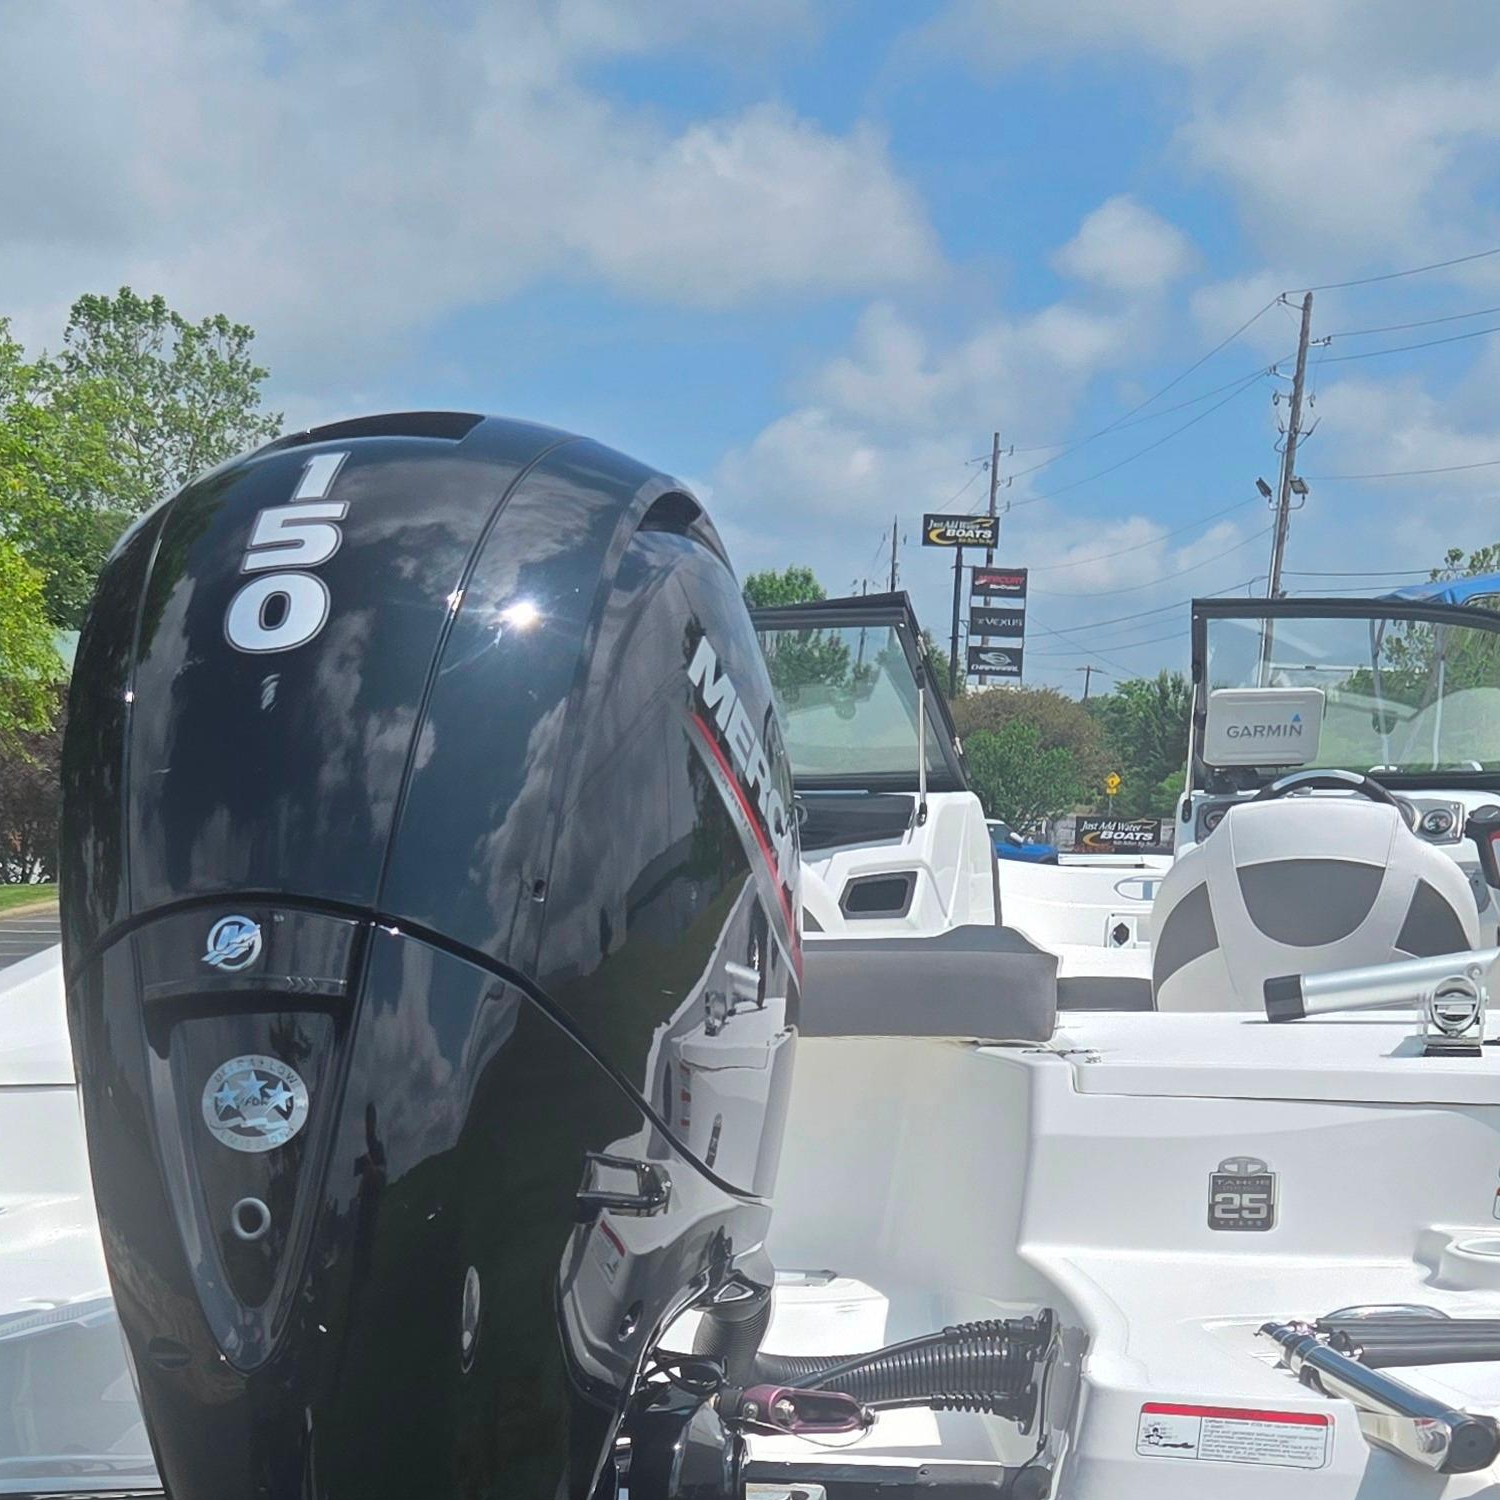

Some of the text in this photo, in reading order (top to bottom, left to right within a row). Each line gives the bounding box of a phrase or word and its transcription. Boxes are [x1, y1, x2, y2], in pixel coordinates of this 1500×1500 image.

[946, 528, 993, 539] BOATS
[224, 451, 351, 654] 150
[1227, 724, 1303, 739] GARMIN
[1080, 820, 1142, 832] Just Add Water
[1100, 830, 1154, 841] BOATS
[1214, 1193, 1268, 1219] 25
